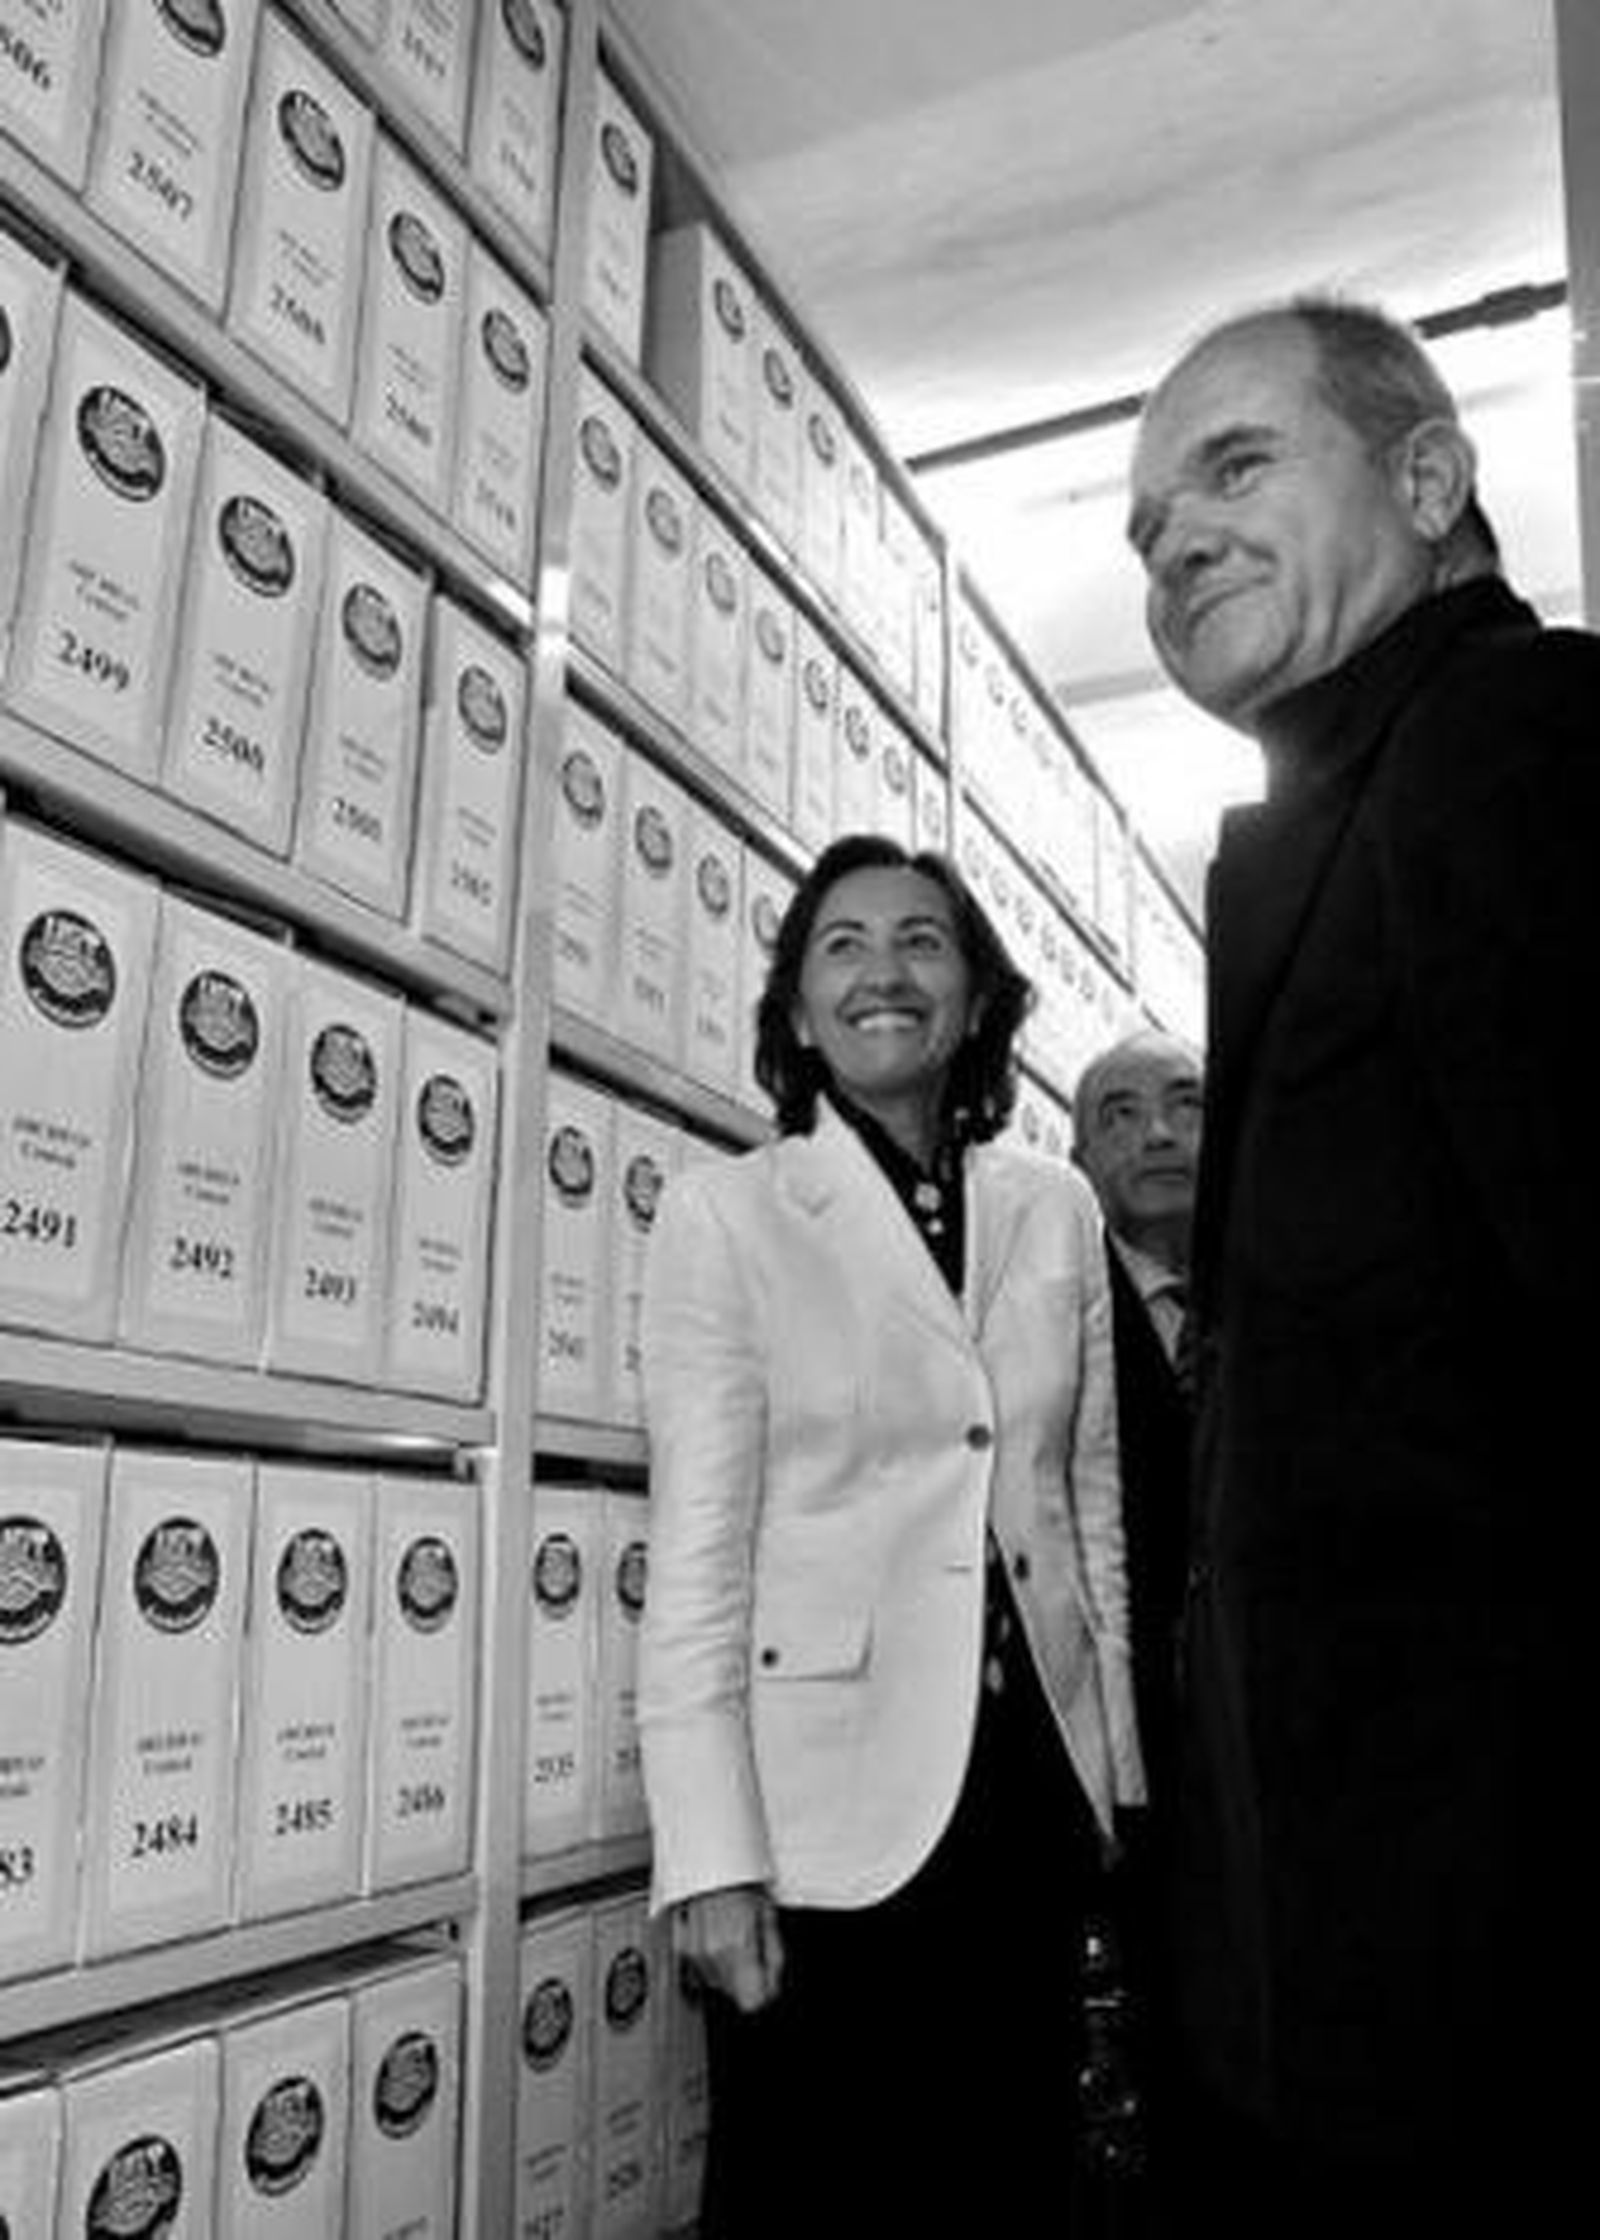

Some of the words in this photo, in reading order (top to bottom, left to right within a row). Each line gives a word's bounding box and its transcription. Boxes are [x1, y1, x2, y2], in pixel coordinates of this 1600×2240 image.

[57, 630, 130, 693] 2499
[0, 1200, 77, 1249] 2491
[168, 1237, 236, 1280] 2492
[131, 1813, 198, 1859] 2484
[275, 1799, 334, 1837] 2485
